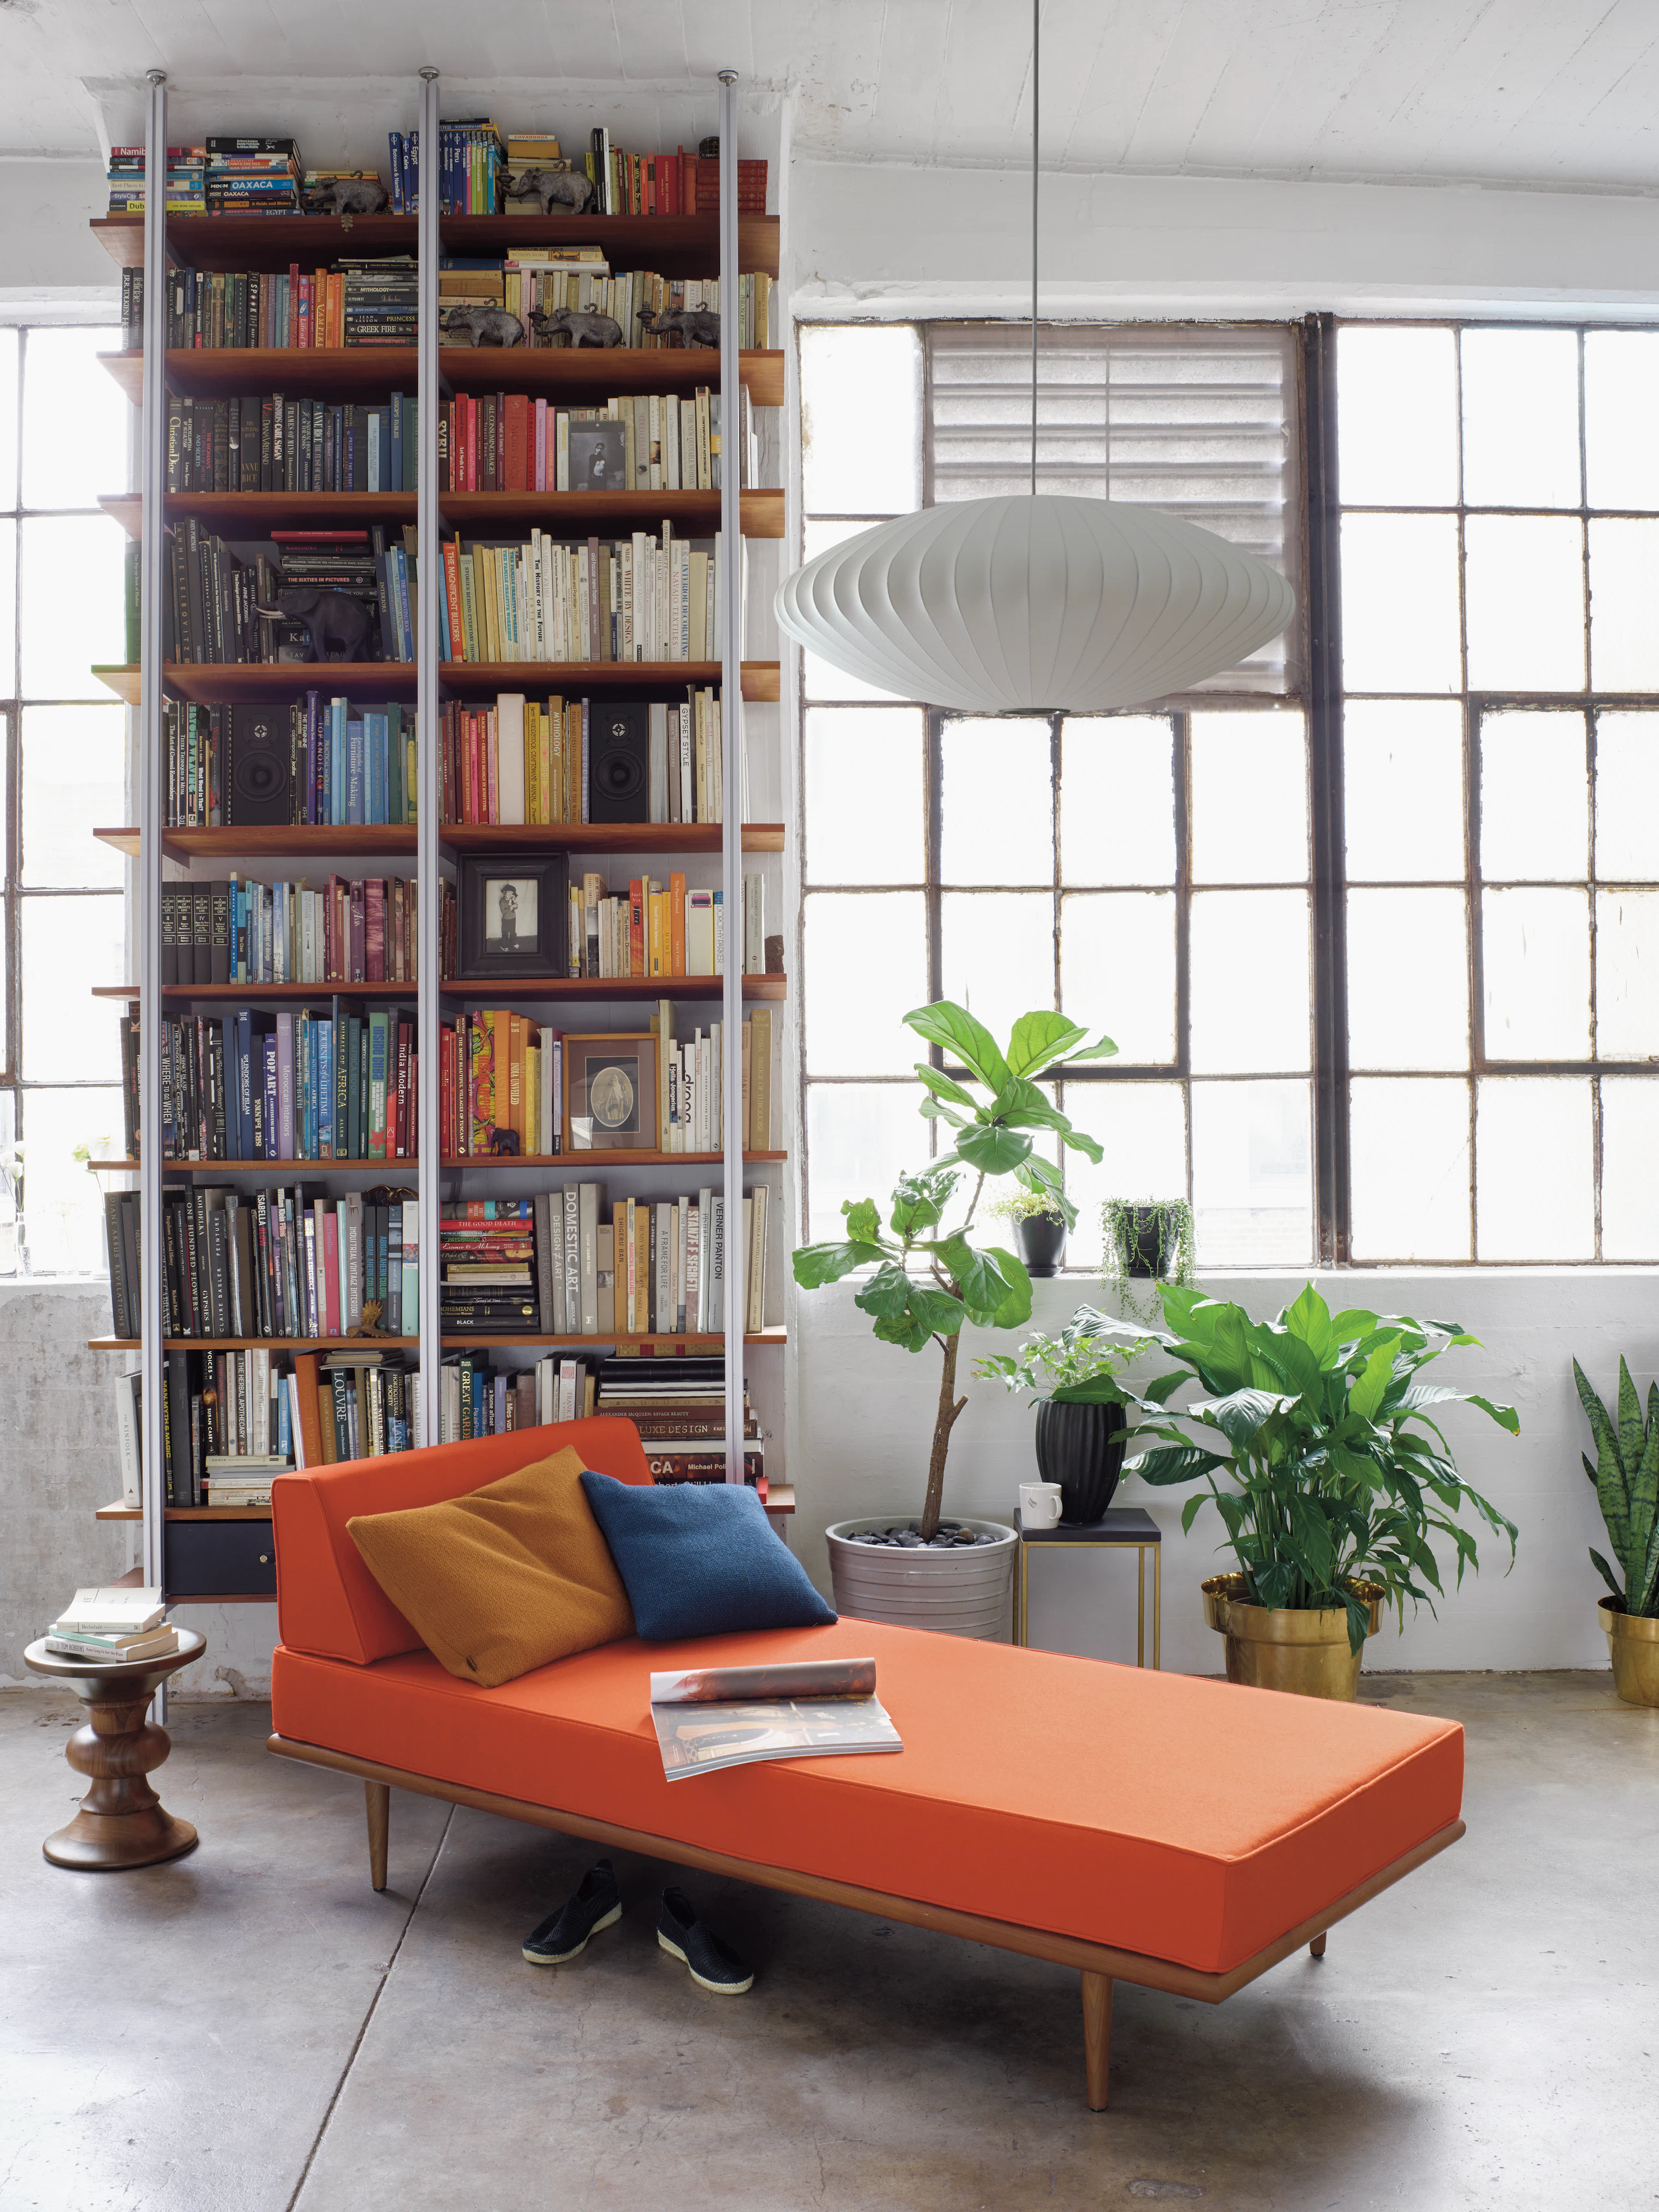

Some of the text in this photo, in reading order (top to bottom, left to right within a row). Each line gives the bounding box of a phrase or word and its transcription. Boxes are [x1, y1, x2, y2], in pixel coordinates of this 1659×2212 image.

[232, 181, 273, 189] OAXACA
[133, 277, 143, 303] felidae
[168, 417, 181, 474] Christian Dior
[274, 397, 283, 460] COSMOS CARL SAGAN
[639, 433, 647, 461] CHANEL
[176, 527, 190, 651] ANNIE LEIBOVITZ
[448, 567, 458, 610] MAGNIFICENT
[452, 611, 461, 642] BUILDERS
[189, 706, 197, 792] BEYOND WEAVING
[349, 776, 357, 807] Making
[162, 1057, 171, 1085] WHERE
[266, 1051, 277, 1096] POP ART
[340, 1055, 345, 1065] OF
[338, 1067, 347, 1109] AFRICA
[398, 1070, 406, 1104] Modern
[497, 1056, 507, 1116] RAJASTHAN
[511, 1063, 520, 1105] INDIA UNVEILED
[757, 1081, 765, 1092] OF
[163, 1101, 172, 1123] WHEN
[756, 1092, 765, 1132] TURQUOISE
[257, 1195, 267, 1247] ISABELLA BLOW
[566, 1192, 578, 1262] DOMESTIC
[715, 1203, 724, 1239] VERNER
[568, 1267, 579, 1293] ART
[334, 1372, 346, 1422] LOUVRE
[69, 1644, 84, 1652] ROBBINS
